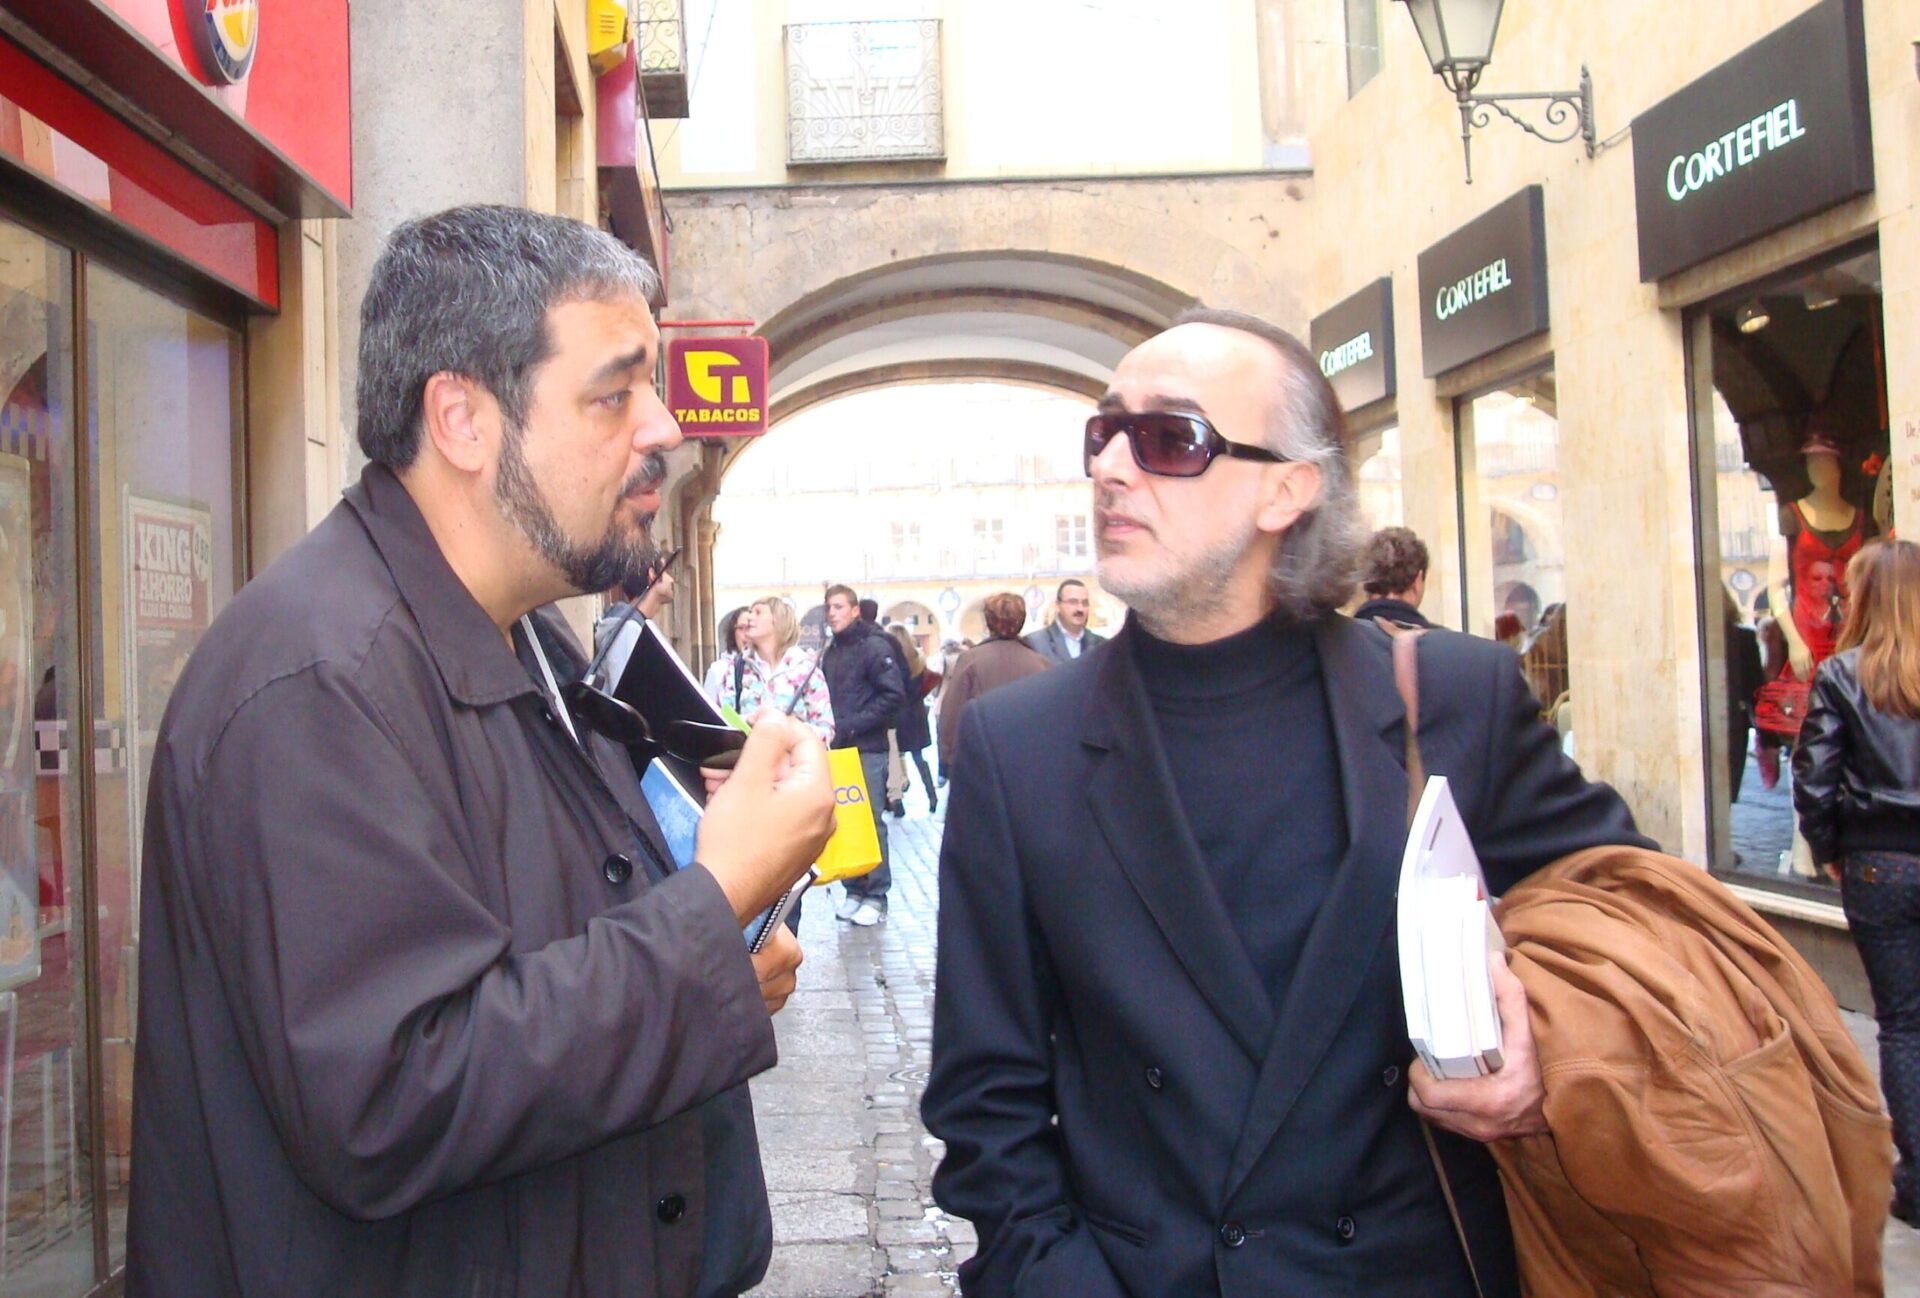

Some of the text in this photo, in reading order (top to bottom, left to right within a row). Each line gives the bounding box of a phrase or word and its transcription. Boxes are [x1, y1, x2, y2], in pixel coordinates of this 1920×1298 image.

[1666, 98, 1806, 201] CORTEFIEL
[1436, 257, 1512, 321] CORTEFIEL
[1319, 331, 1373, 378] CORTEFIEL
[675, 407, 760, 423] TABACOS
[138, 521, 192, 575] KING
[140, 570, 193, 605] AHORRO
